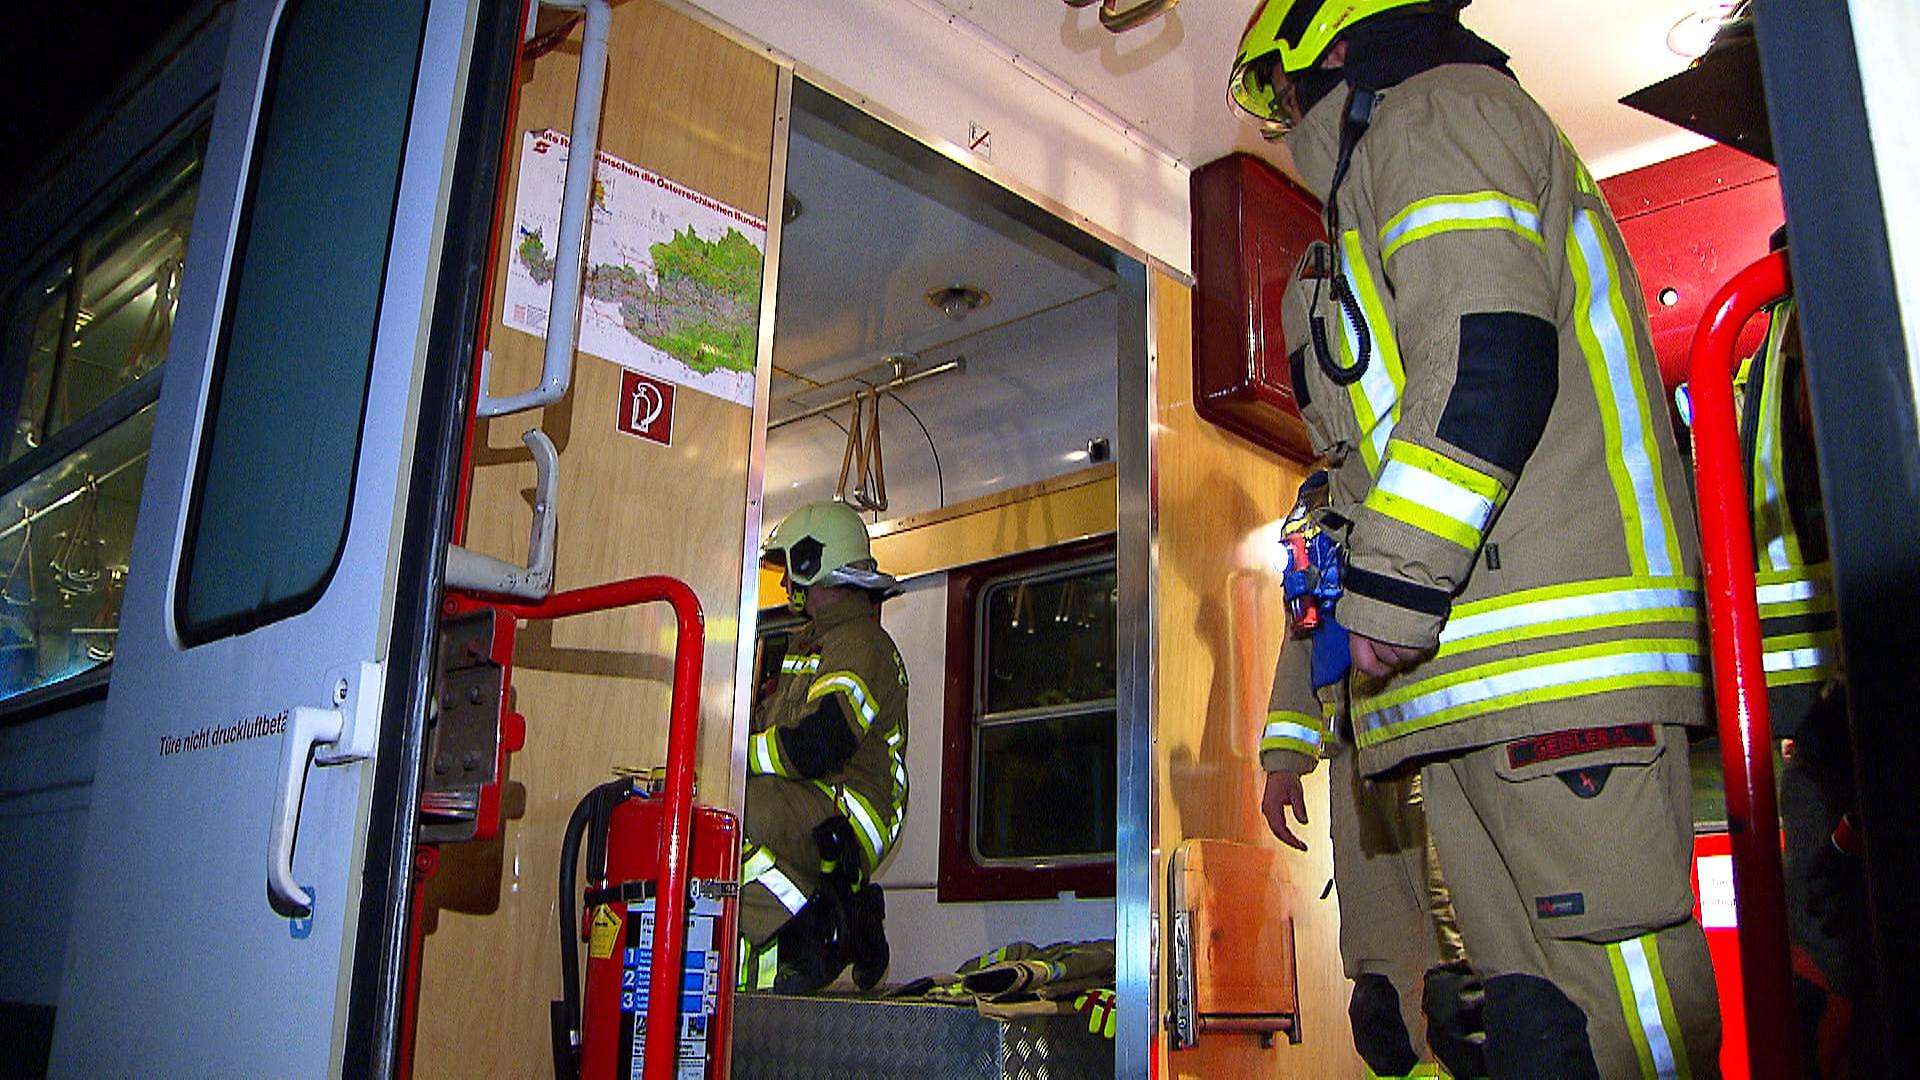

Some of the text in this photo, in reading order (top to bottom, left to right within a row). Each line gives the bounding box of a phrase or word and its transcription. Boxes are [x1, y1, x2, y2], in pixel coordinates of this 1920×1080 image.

[597, 152, 640, 178] ünschen
[641, 172, 656, 185] die
[160, 709, 289, 757] Türe nicht druckluftbetä
[627, 947, 636, 965] 1
[623, 969, 637, 988] 2
[621, 991, 635, 1009] 3
